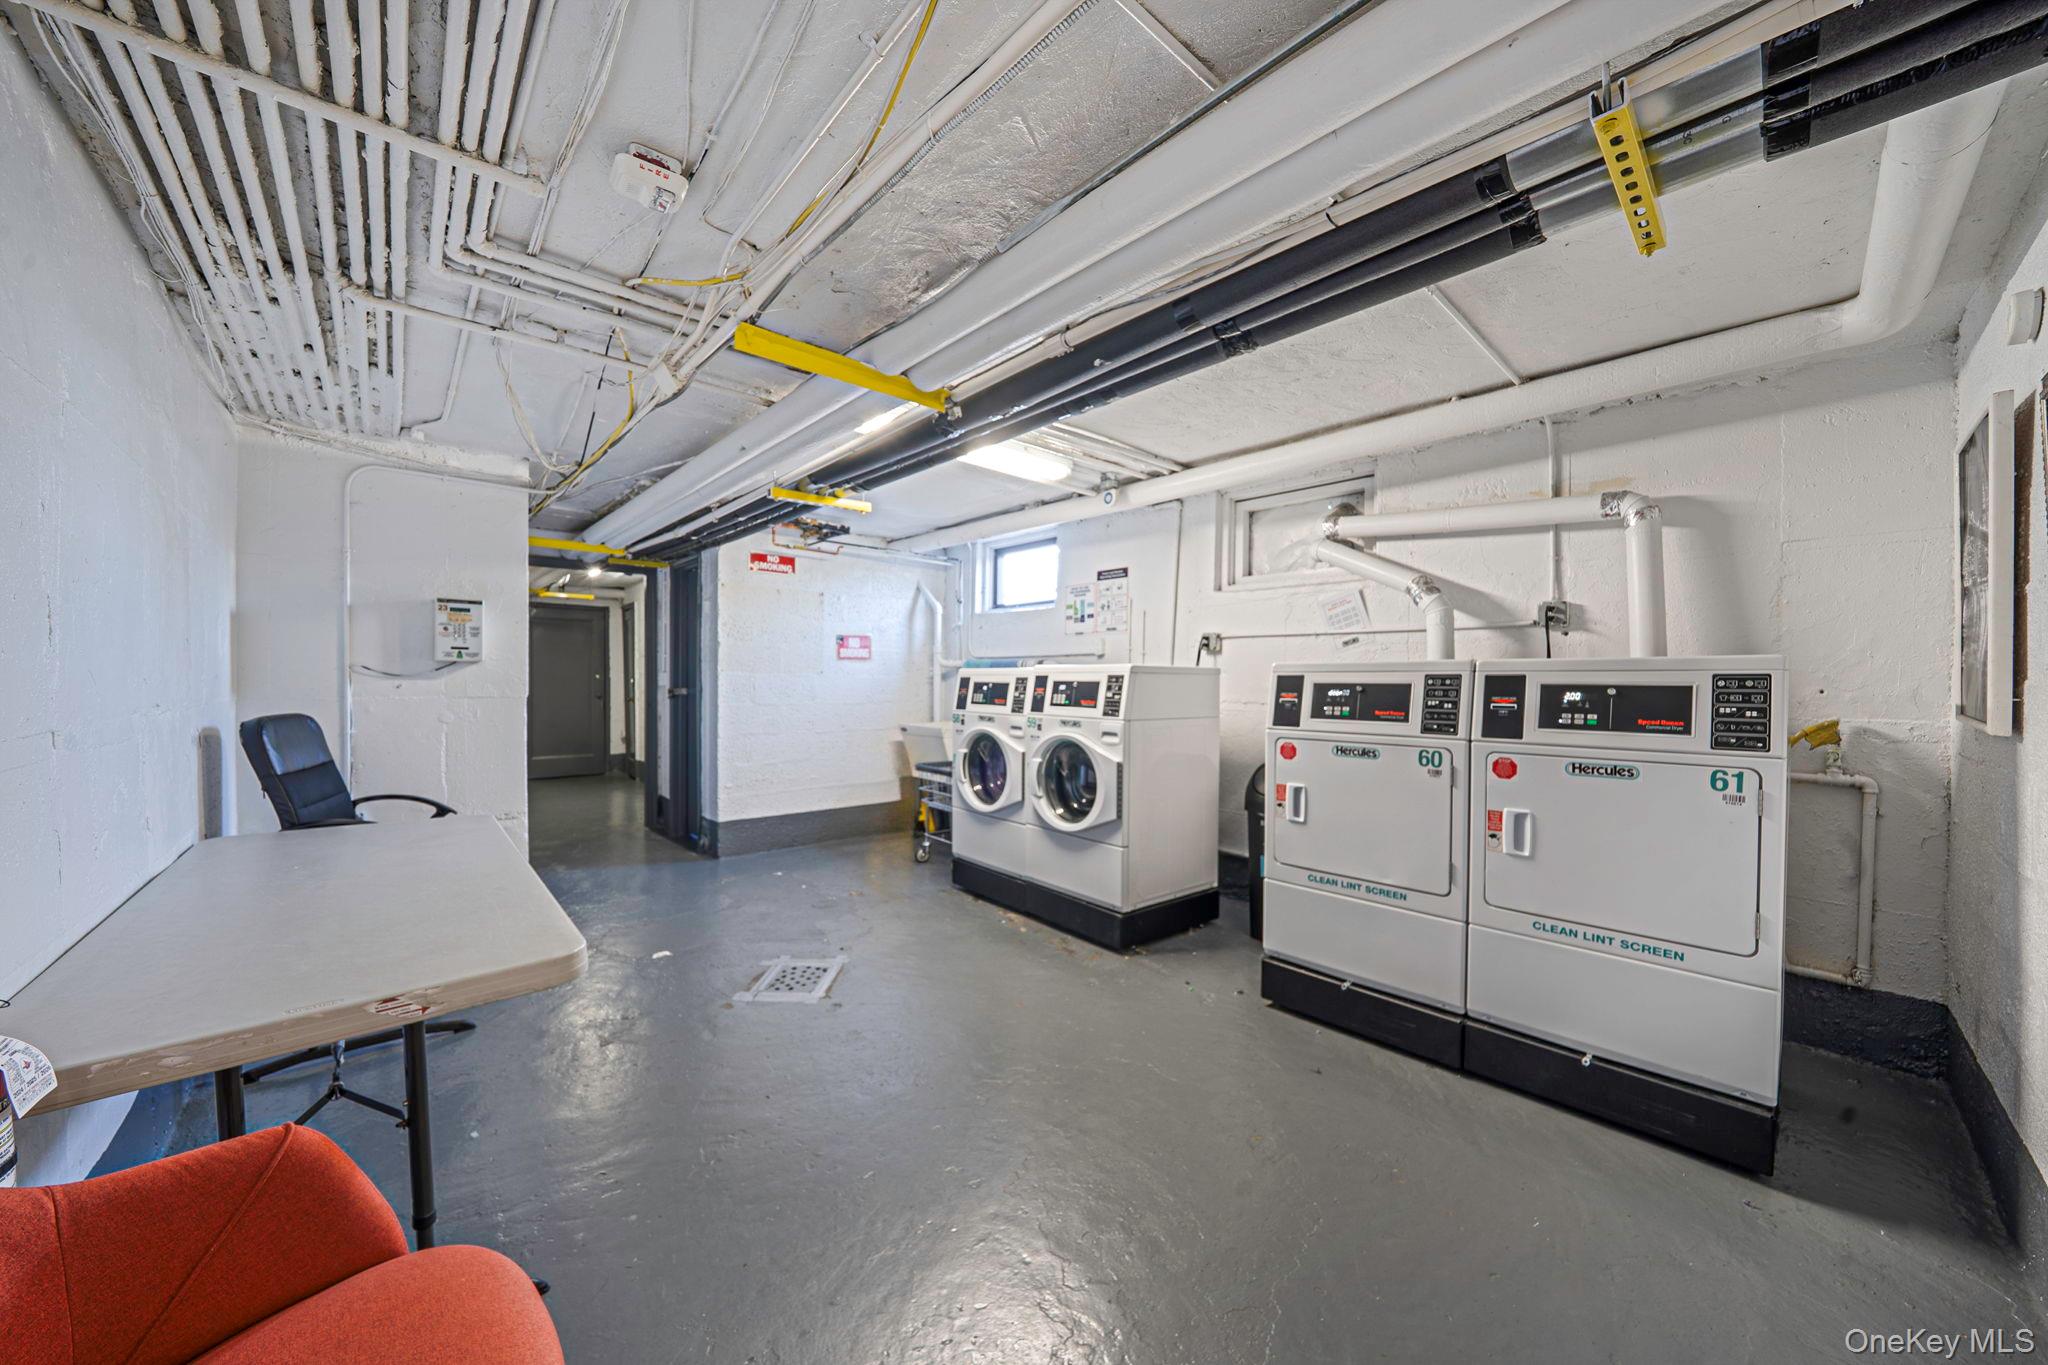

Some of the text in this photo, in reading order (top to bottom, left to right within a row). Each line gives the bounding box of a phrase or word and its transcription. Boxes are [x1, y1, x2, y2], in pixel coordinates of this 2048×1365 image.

[639, 163, 670, 179] FIRE
[753, 560, 793, 573] SMOKING
[767, 555, 780, 563] NO
[1335, 745, 1377, 758] Hercules
[1418, 749, 1443, 768] 60
[1571, 763, 1634, 777] Hercules
[1709, 769, 1744, 794] 61
[1307, 873, 1407, 901] CLEAN LINT SCREEN
[1532, 921, 1685, 962] CLEAN LINT SCREEN
